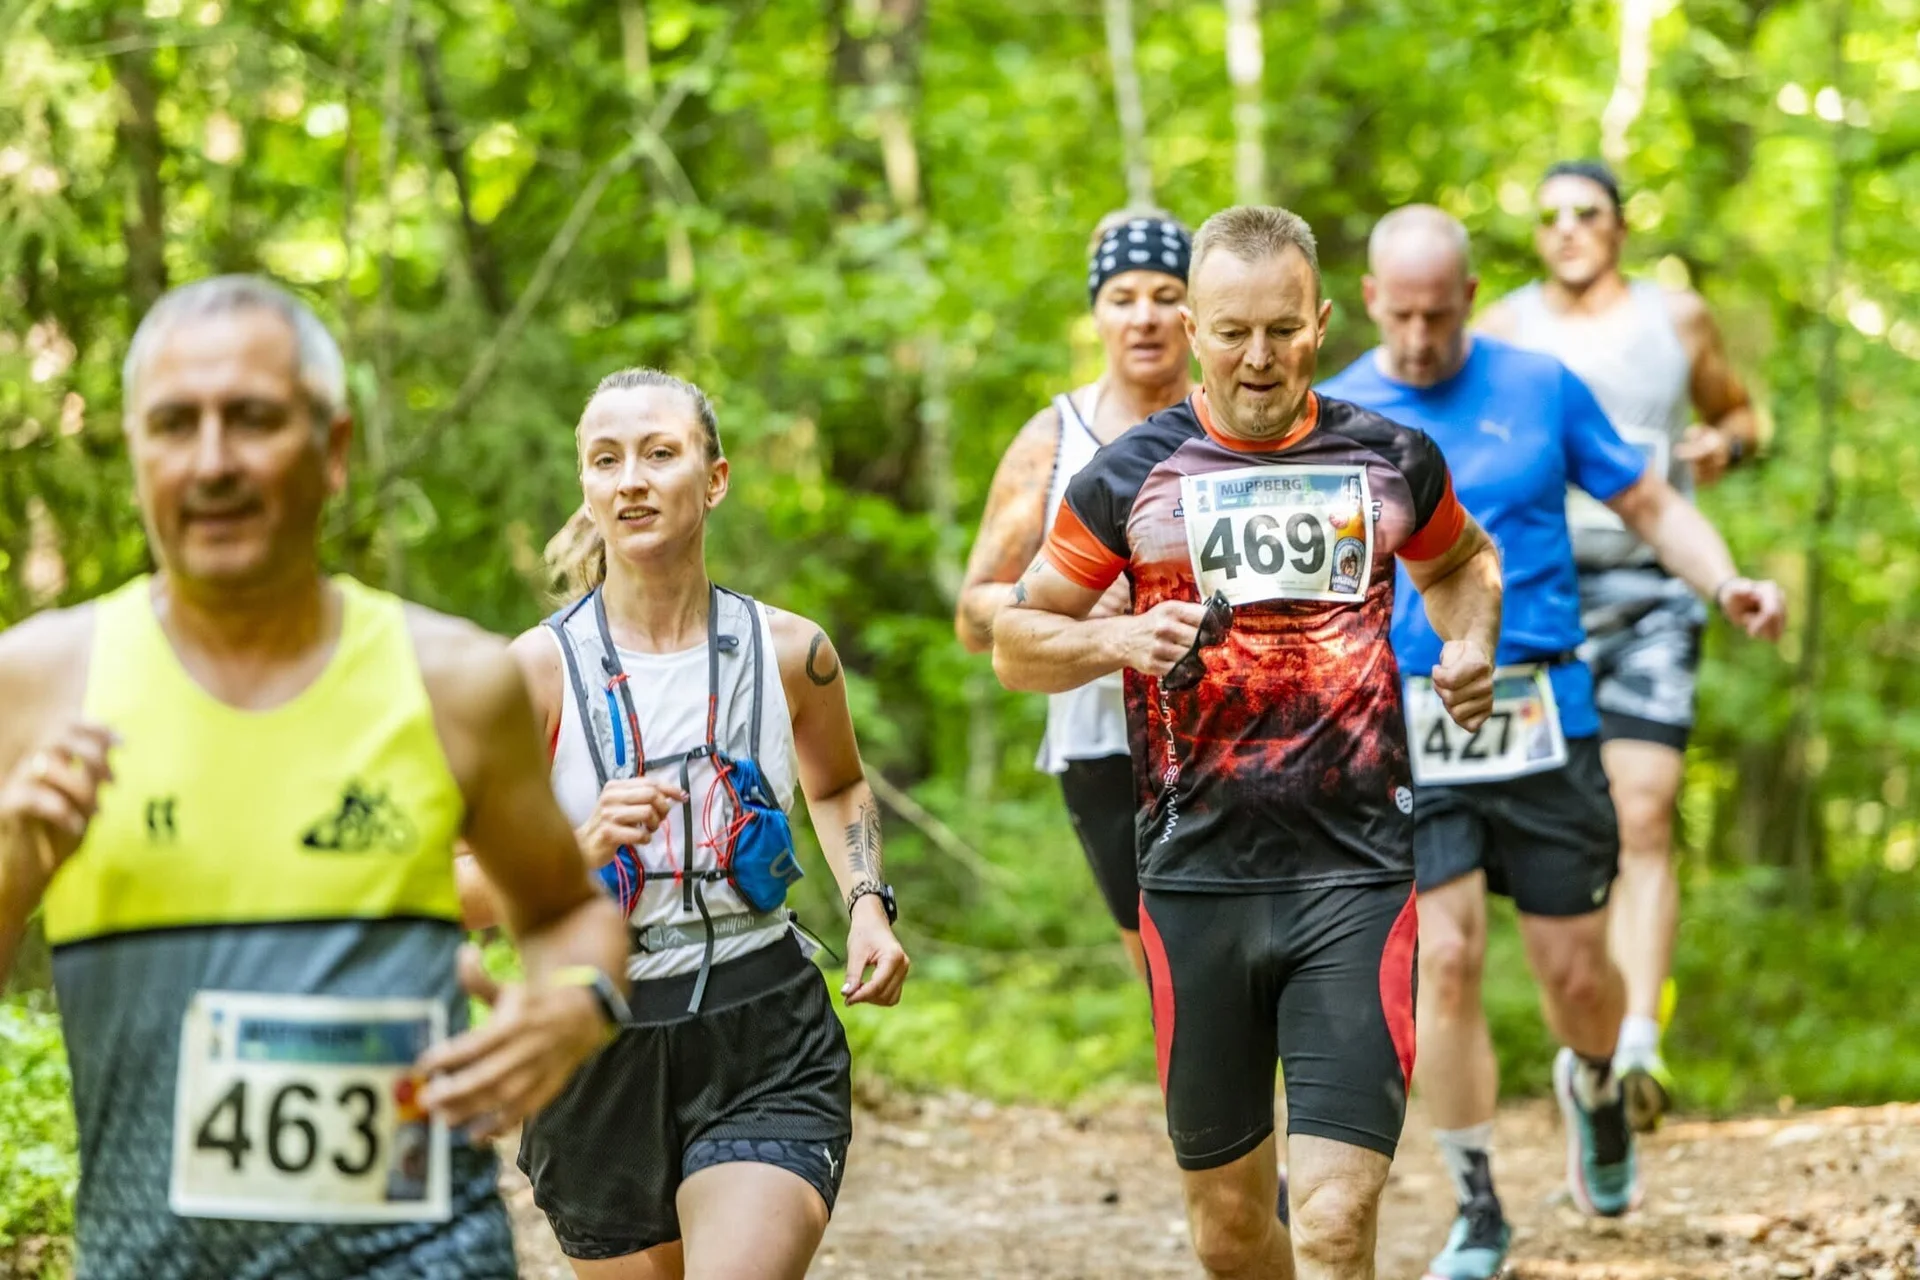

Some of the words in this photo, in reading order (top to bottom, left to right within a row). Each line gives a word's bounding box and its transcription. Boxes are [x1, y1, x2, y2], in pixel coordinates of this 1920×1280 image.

[1221, 479, 1302, 496] MUPPBERG
[1200, 512, 1326, 580] 469
[1424, 711, 1512, 761] 427
[197, 1078, 379, 1176] 463
